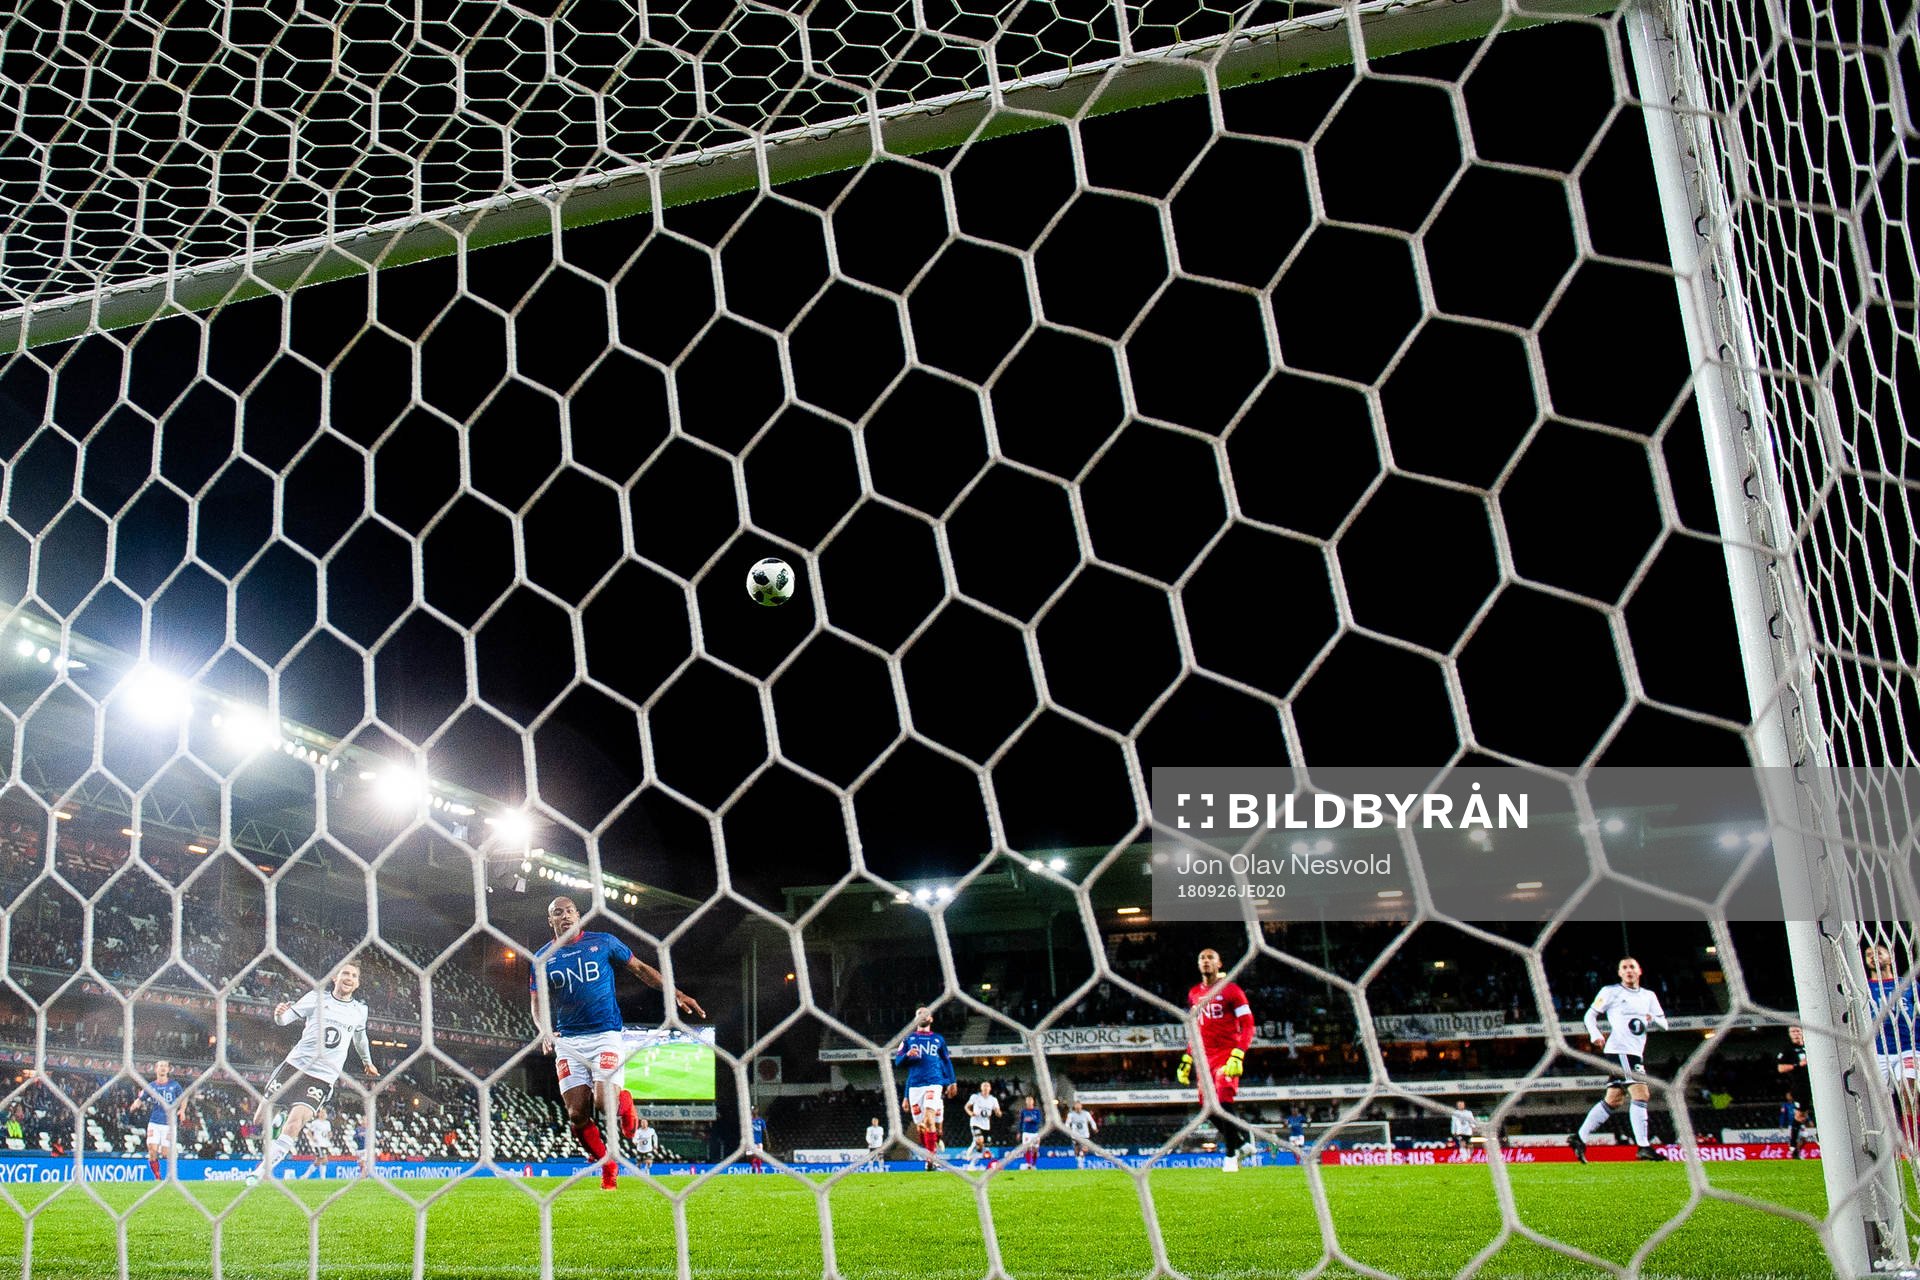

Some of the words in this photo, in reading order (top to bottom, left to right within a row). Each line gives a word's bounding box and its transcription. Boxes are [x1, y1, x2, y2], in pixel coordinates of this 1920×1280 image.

[550, 957, 600, 994] DNB
[1040, 1030, 1121, 1045] OSENBORG
[1655, 1146, 1746, 1161] ORGSHUS
